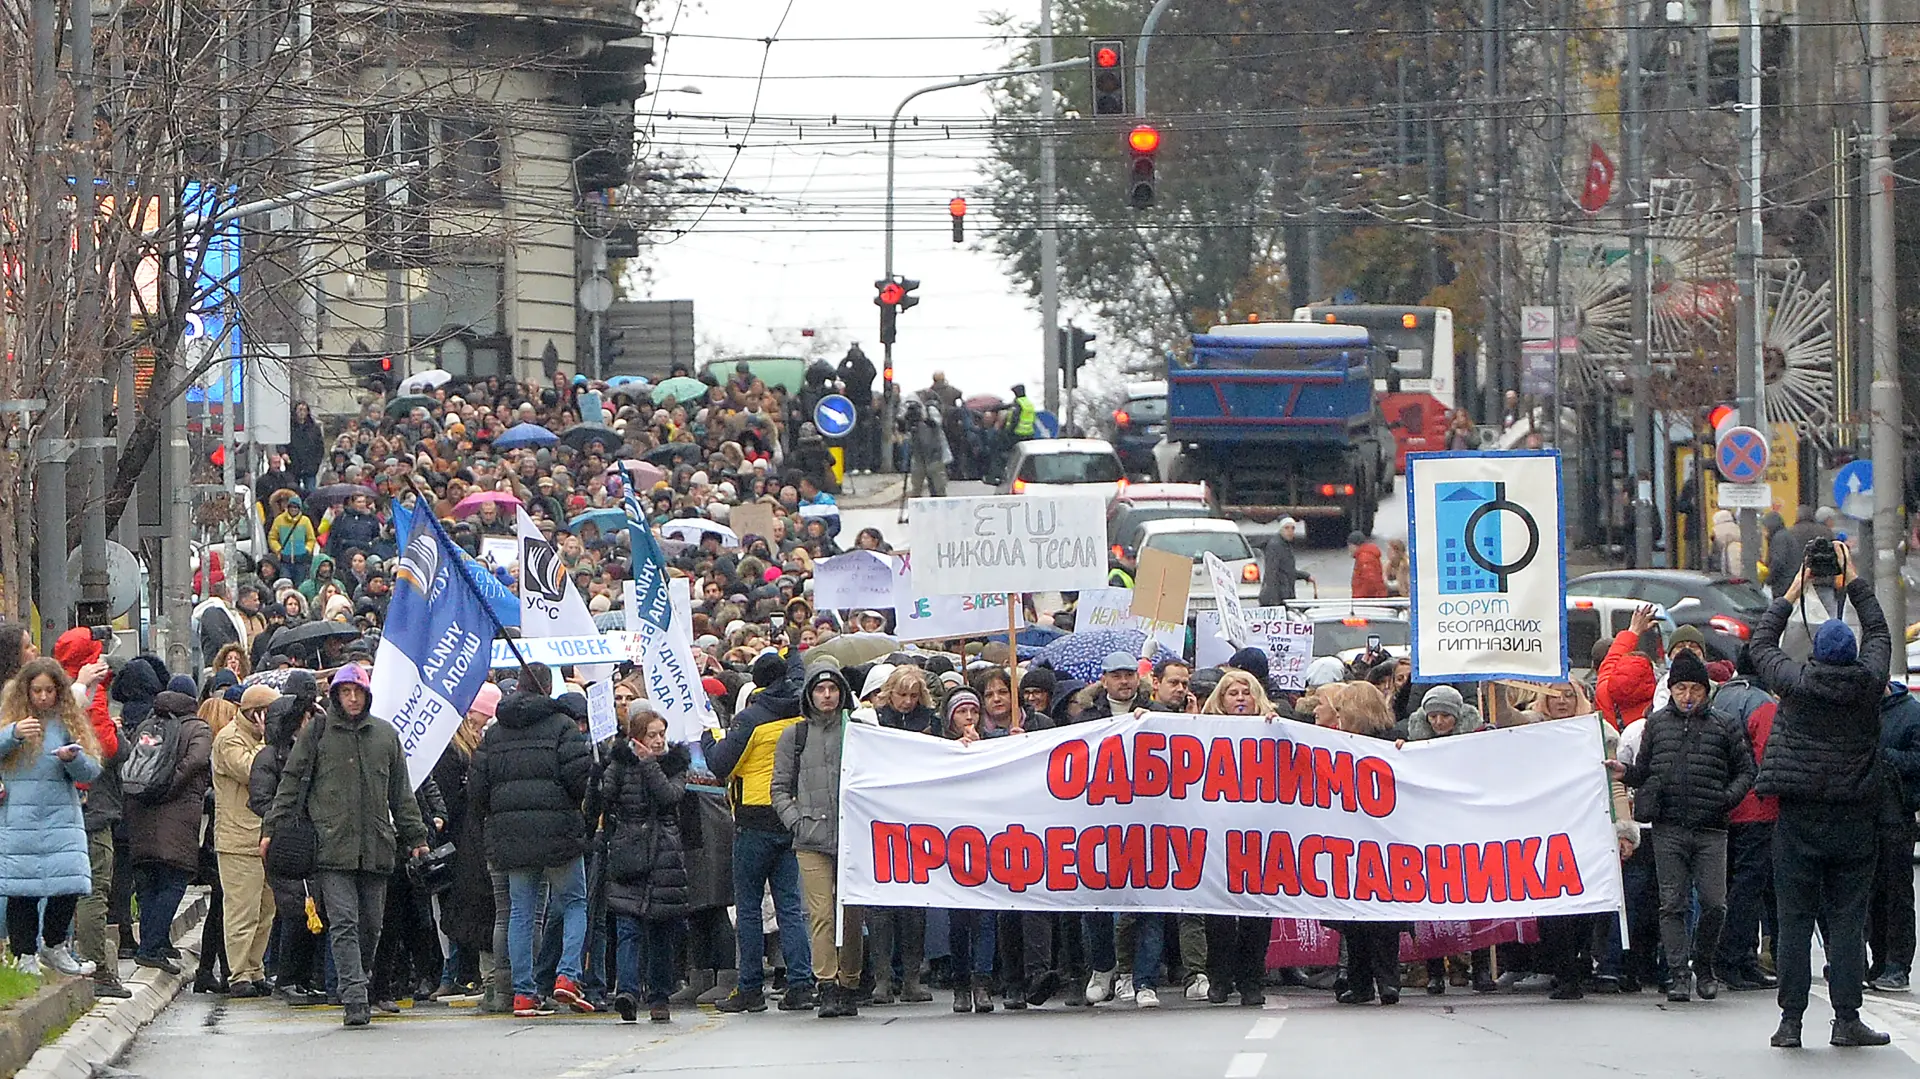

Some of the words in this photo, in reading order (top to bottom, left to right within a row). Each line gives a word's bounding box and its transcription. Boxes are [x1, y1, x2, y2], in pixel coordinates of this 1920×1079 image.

[937, 538, 1026, 568] НИКОЛА
[1438, 598, 1510, 616] ФОРУМ
[1438, 618, 1542, 633] БЕОГРАДСКИХ
[547, 639, 613, 659] ЧОВЕК
[1438, 636, 1543, 653] ГИМНАЗИЈА
[659, 642, 694, 713] ДИКАТА
[1047, 732, 1396, 818] ОДБРАНИМО
[871, 821, 1208, 894] ПРОФЕСИЈУ
[1225, 830, 1584, 904] НАСТАВНИКА
